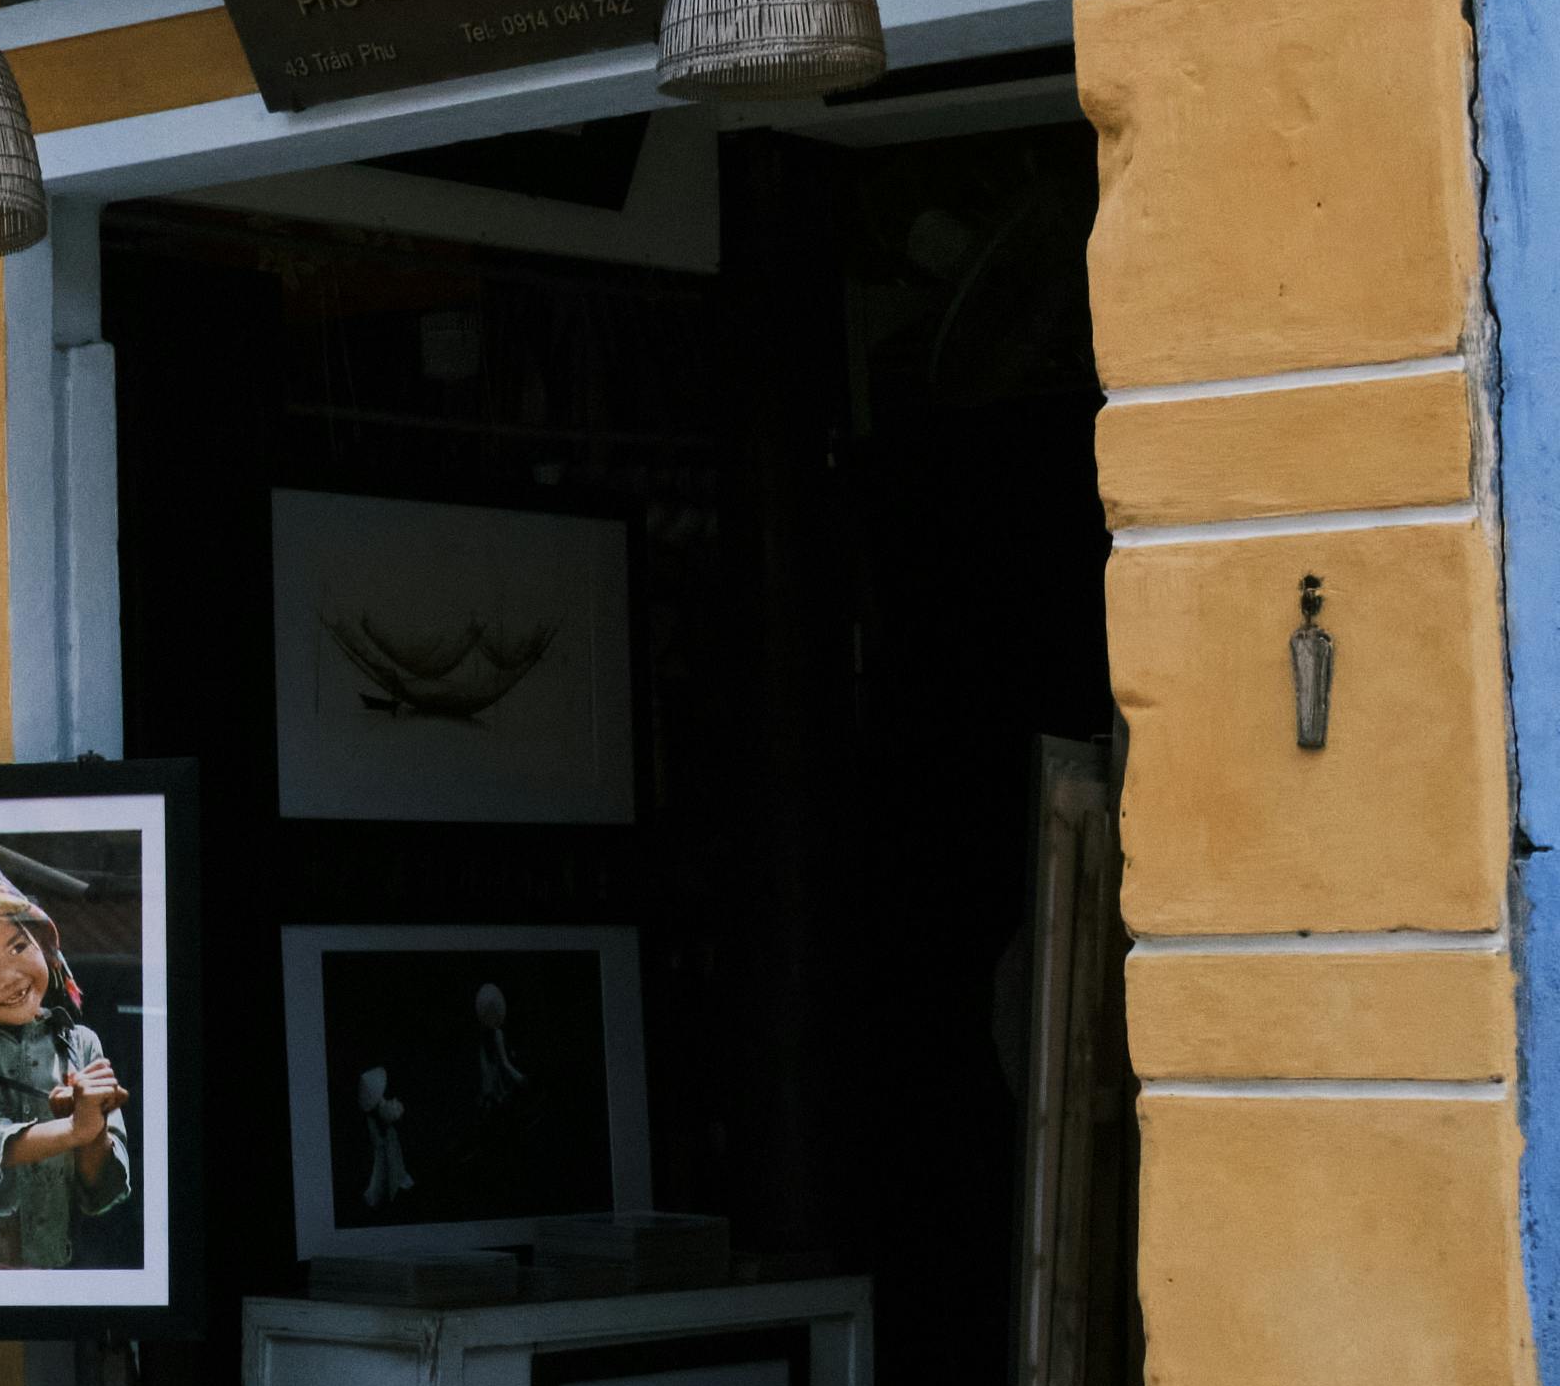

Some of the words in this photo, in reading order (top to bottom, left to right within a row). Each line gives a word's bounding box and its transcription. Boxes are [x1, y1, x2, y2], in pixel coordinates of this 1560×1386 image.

[501, 9, 549, 36] 0914
[553, 1, 591, 26] 041
[285, 56, 310, 78] 43
